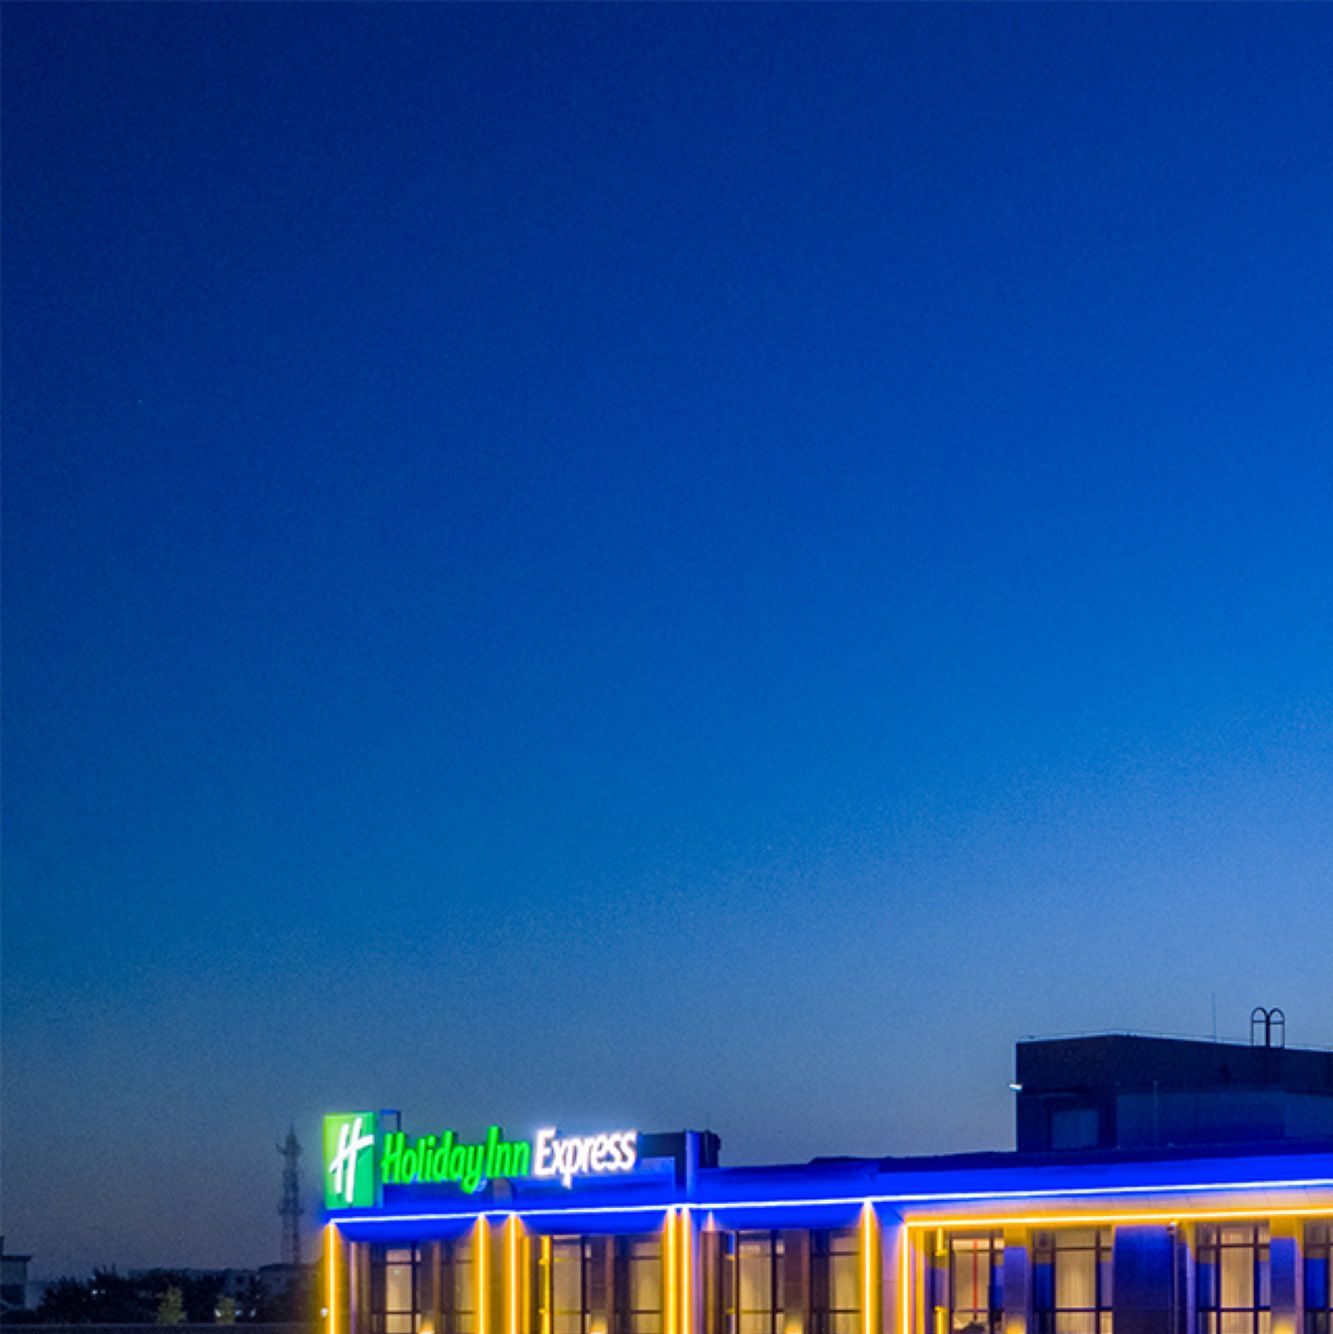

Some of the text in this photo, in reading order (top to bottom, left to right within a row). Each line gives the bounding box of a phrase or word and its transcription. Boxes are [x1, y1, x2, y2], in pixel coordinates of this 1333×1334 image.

[381, 1125, 637, 1194] Holiday Inn Express
